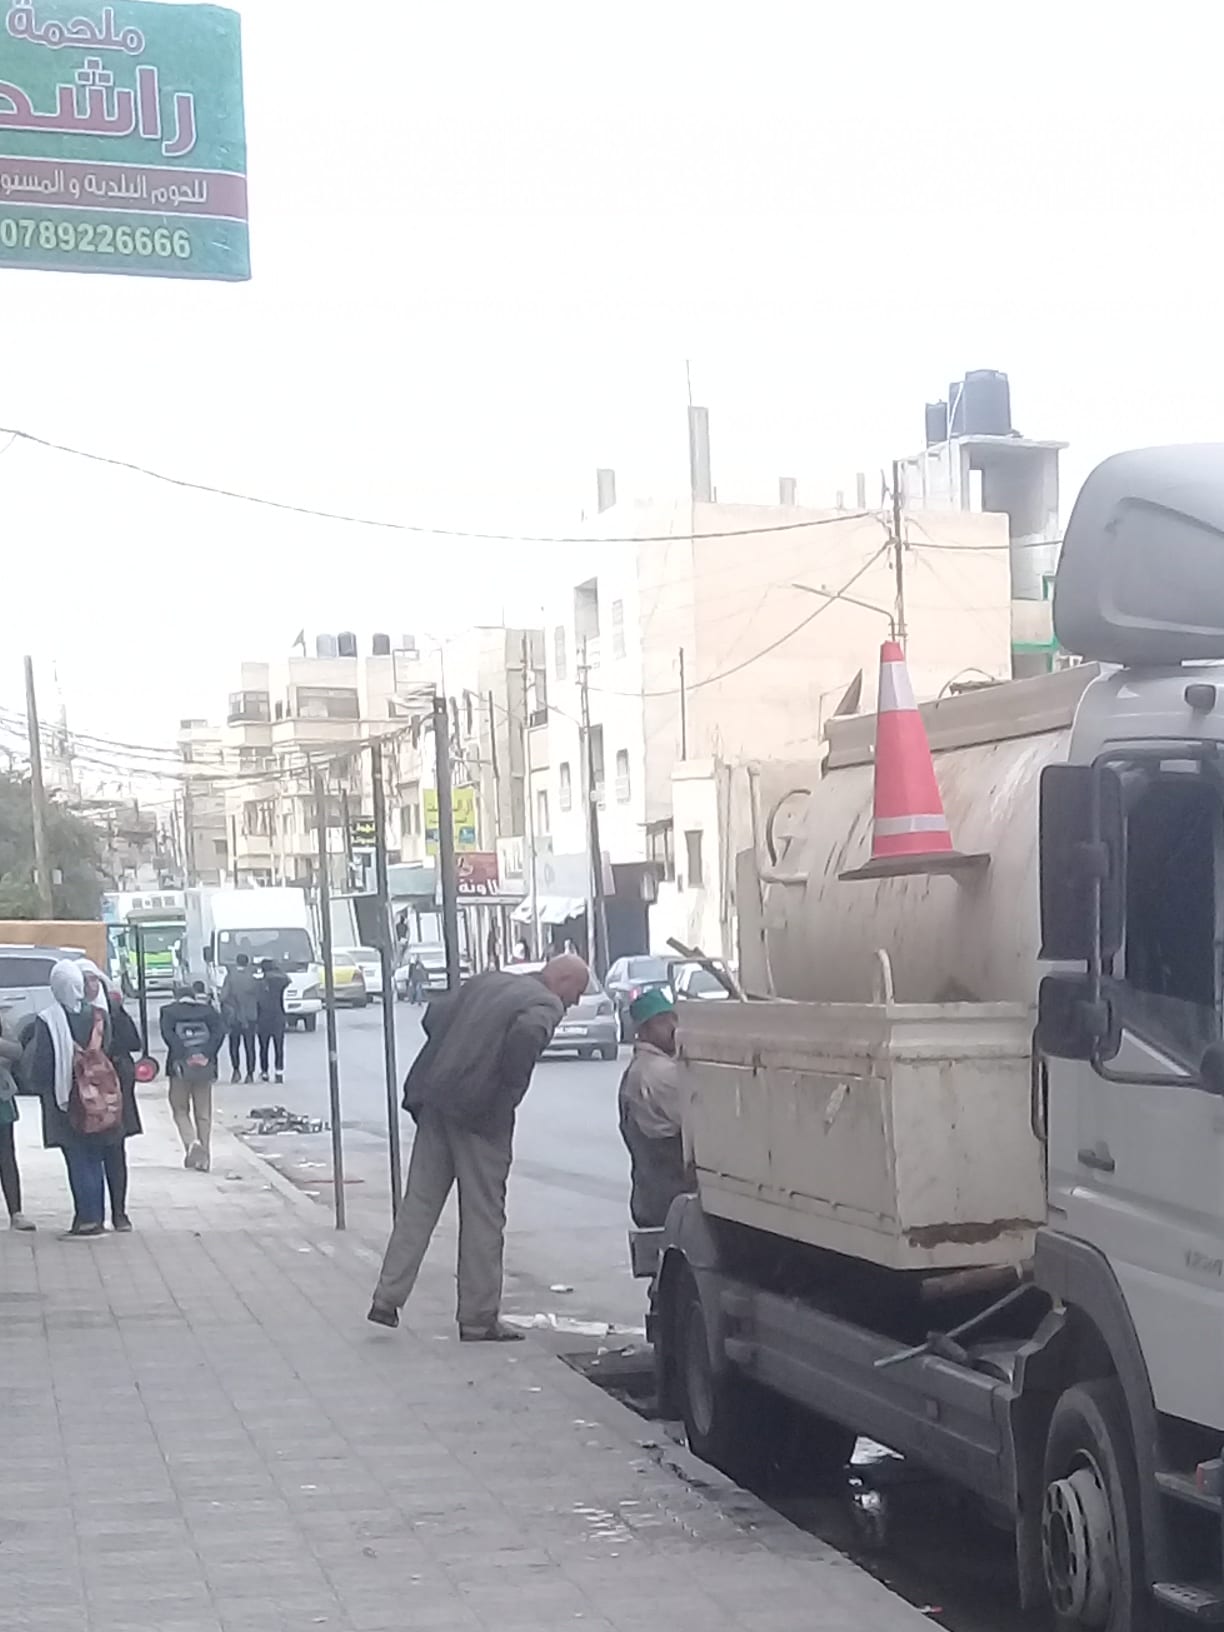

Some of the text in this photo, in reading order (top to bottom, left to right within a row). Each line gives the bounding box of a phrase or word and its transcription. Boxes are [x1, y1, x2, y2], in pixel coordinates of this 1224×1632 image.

[6, 0, 145, 55] ملحمة
[151, 179, 208, 206] للحوم
[0, 218, 192, 258] 0789226666
